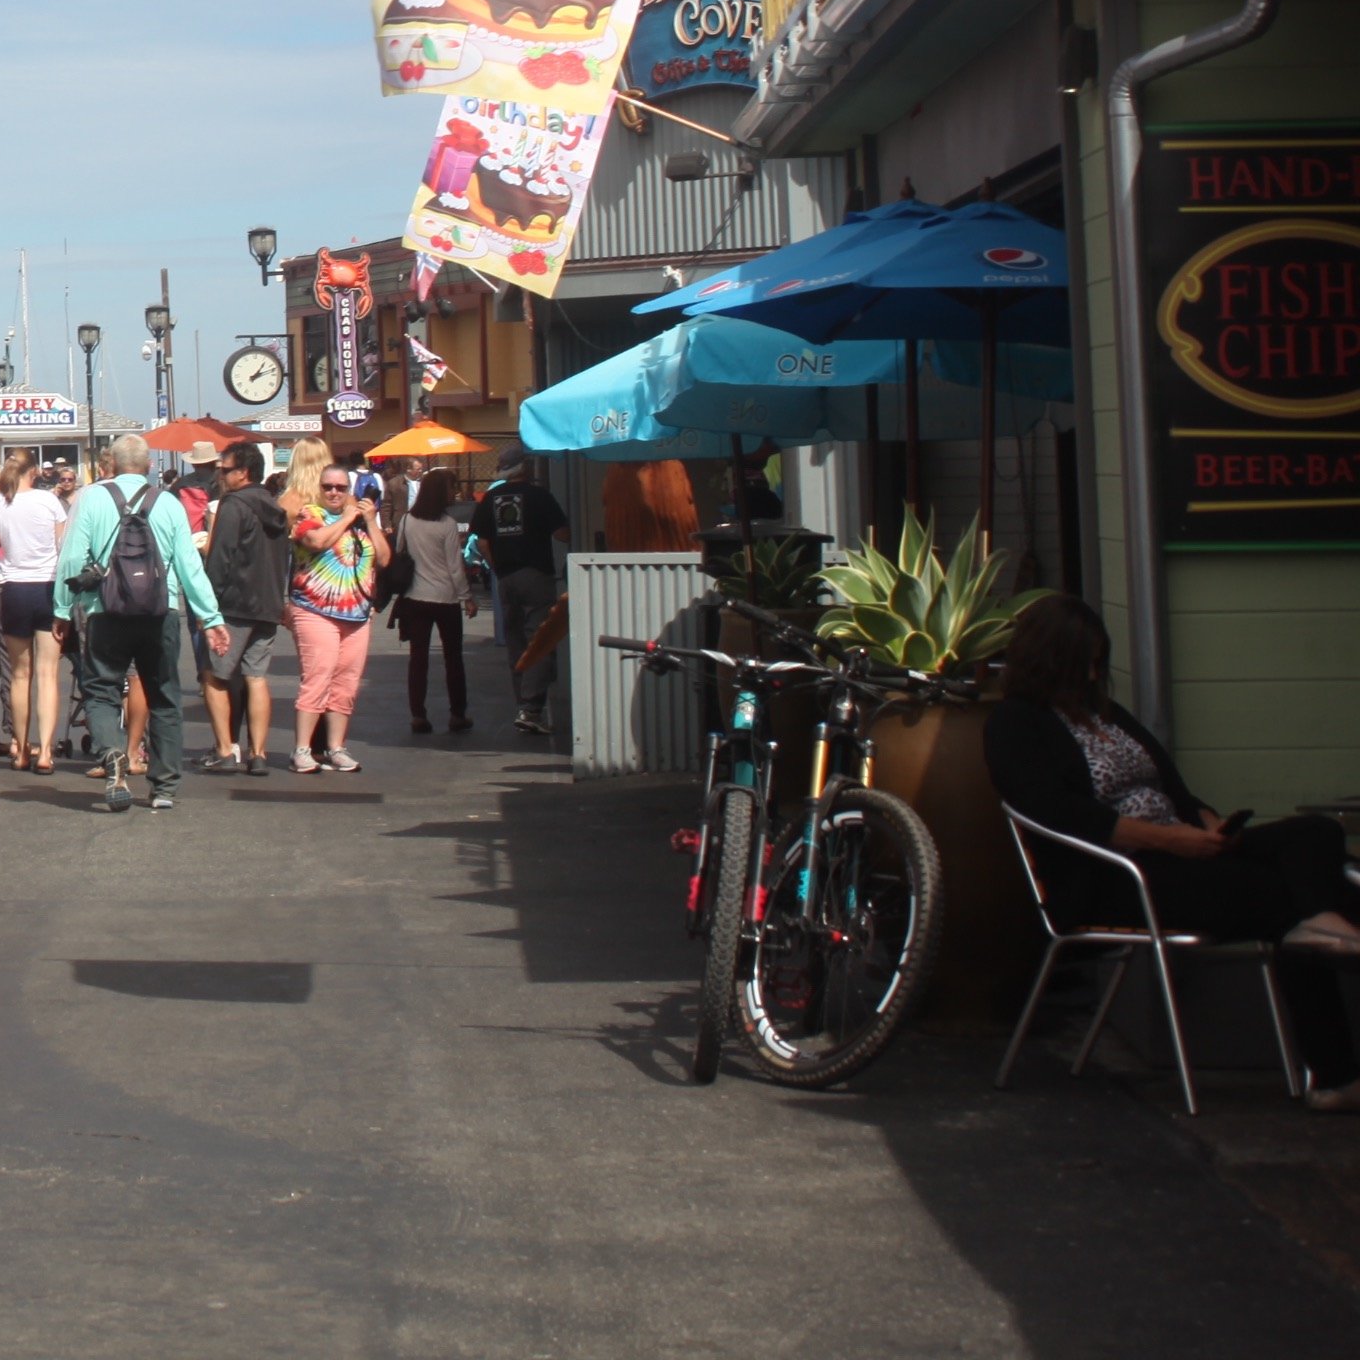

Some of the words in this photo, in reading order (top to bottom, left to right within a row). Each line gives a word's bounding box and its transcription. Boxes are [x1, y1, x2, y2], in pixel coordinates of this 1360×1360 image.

[983, 273, 1049, 285] pepsi
[1217, 262, 1360, 321] FISH
[340, 297, 351, 336] CRAB
[1218, 323, 1360, 381] CHIP
[343, 340, 353, 388] HOUSE
[777, 354, 834, 375] ONE
[327, 398, 375, 414] SEAFOOD
[337, 409, 367, 422] GRILL
[264, 421, 301, 430] GLASS
[303, 421, 320, 430] BO
[591, 412, 629, 433] ONE
